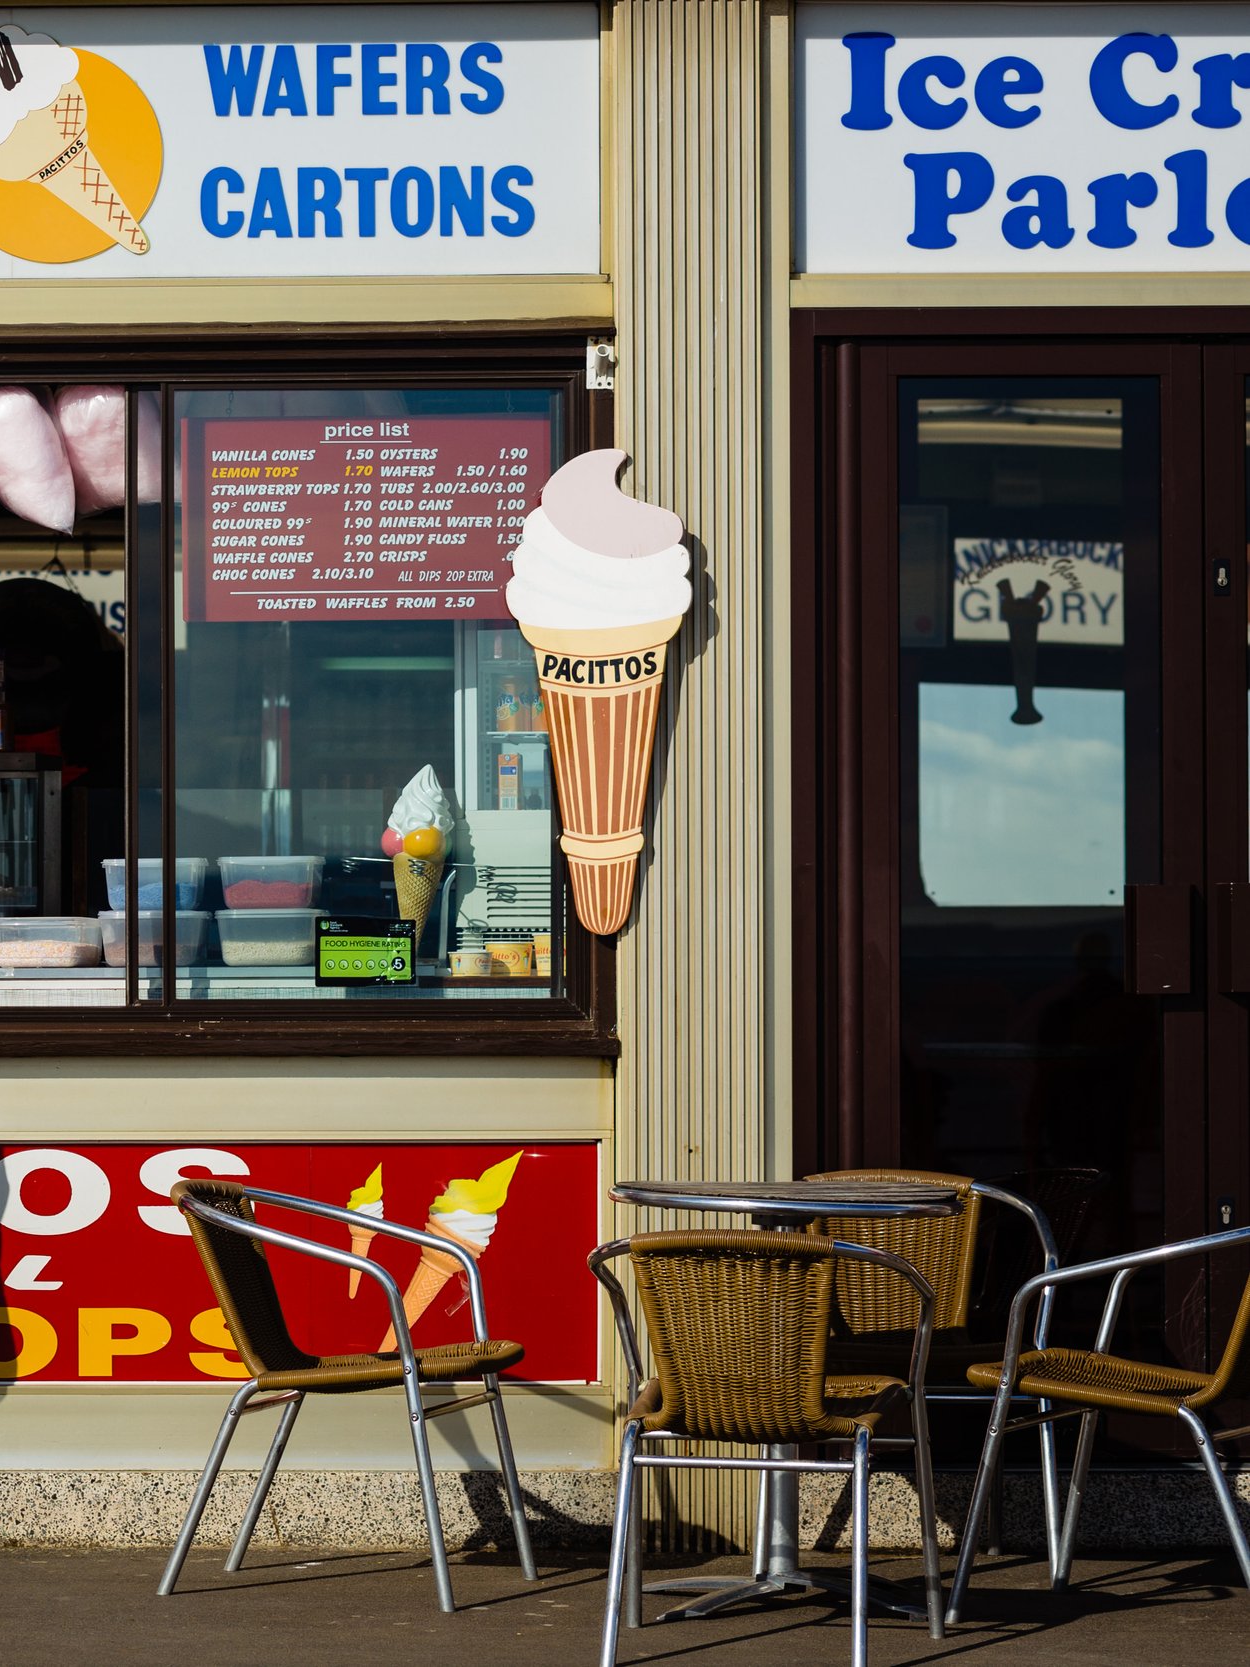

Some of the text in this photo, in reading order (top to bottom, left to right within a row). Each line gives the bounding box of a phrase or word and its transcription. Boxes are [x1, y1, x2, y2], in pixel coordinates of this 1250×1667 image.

[203, 42, 504, 116] WAFERS
[841, 31, 1250, 130] Ice Cr
[37, 138, 85, 181] PACITTOS
[200, 165, 535, 238] CARTONS
[324, 422, 409, 440] price list
[211, 449, 374, 462] VANILLA CONES 1.50
[380, 448, 528, 460] OYSTERS 1.90
[211, 465, 374, 478] LEMON TOPS 1.70
[380, 466, 436, 477] WAFERS
[456, 465, 485, 477] 1.50
[499, 465, 527, 476] 1.60
[211, 483, 372, 496] STRAWBERRY TOPS 1.70
[380, 482, 525, 494] TUBS 2.00/2.60/3.00
[243, 501, 287, 513] CONES
[343, 500, 373, 511] 1.70
[379, 499, 526, 511] COLD CANS 1.00
[212, 518, 282, 530] COLOURED
[343, 517, 373, 528] 1.90
[379, 516, 525, 528] MINERAL WATER 1.00
[212, 534, 373, 547] SUGAR CONES 1.90
[379, 533, 524, 545] CANDY FLOSS 1.50
[213, 551, 374, 564] WAFFLE CONES 2.70
[379, 551, 515, 562] CRISPS .6
[212, 568, 374, 581] CHOC CONES 2.10/3.10
[398, 570, 494, 582] ALL DIPS 20P EXTRA
[257, 597, 475, 610] TOASTED WAFFLES FROM 2.50
[960, 588, 1117, 626] GORY
[542, 652, 657, 684] PACITTOS
[394, 958, 403, 969] 5
